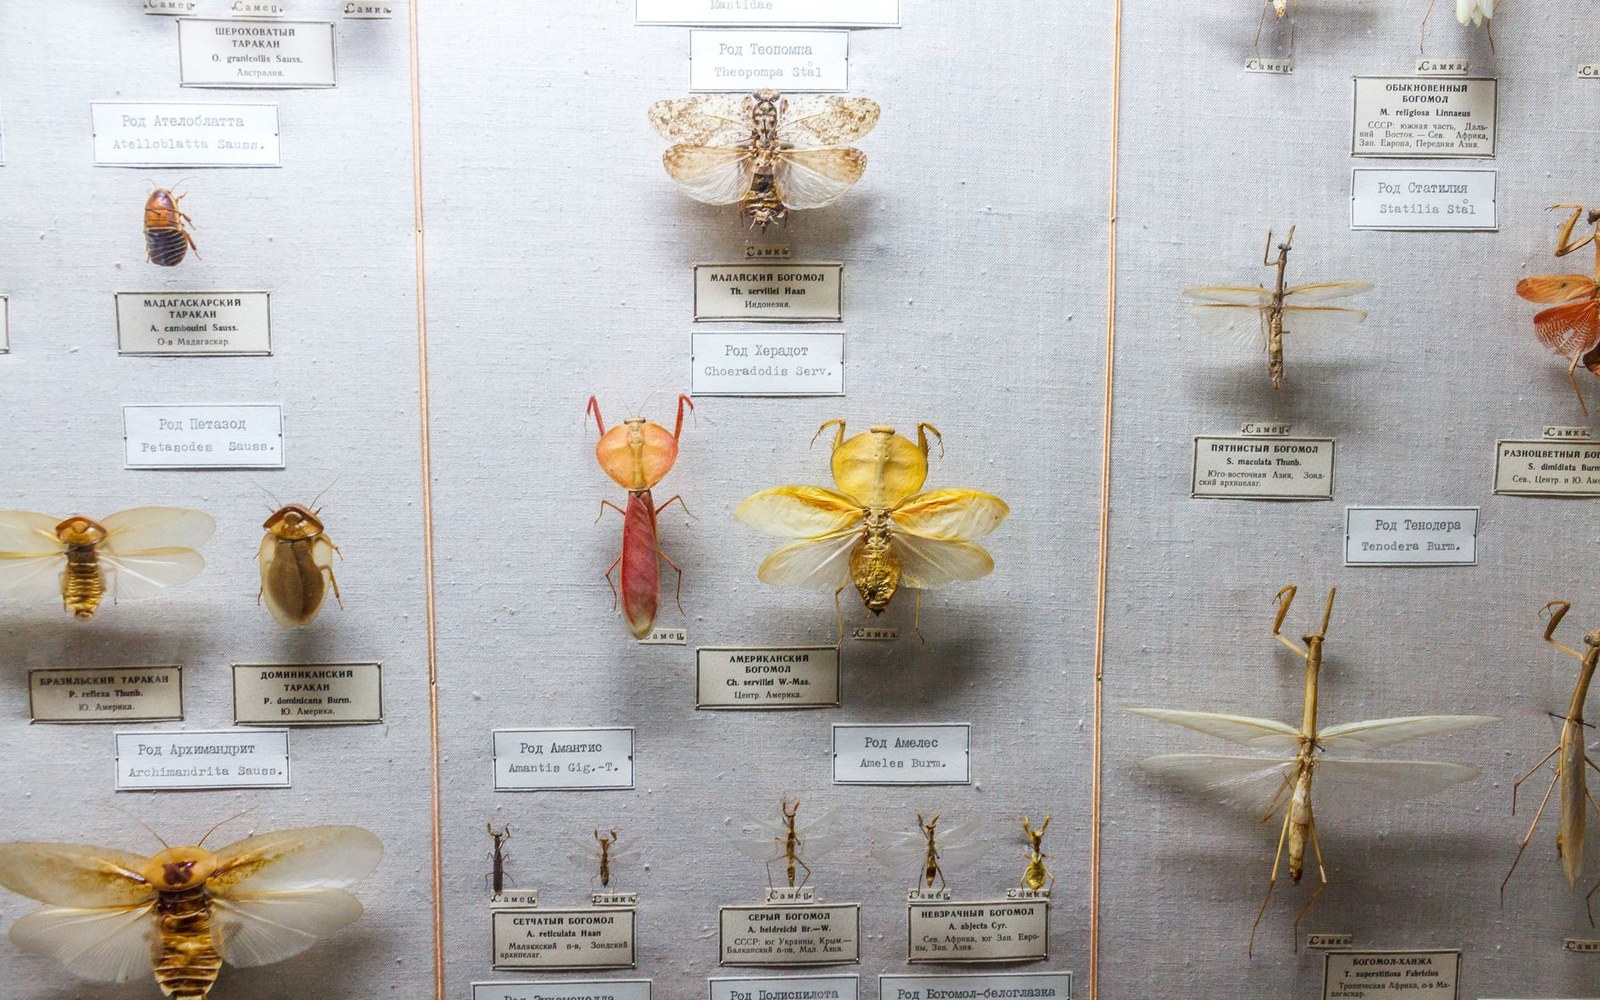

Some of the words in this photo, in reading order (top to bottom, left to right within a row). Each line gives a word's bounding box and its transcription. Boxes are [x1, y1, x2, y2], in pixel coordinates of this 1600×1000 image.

[710, 0, 773, 10] Mantidae
[215, 27, 295, 37] ШЕРОХОВАТЫЙ
[232, 40, 280, 48] ТАРАКАН
[719, 43, 742, 56] Род
[750, 43, 813, 55] Теопомпа
[276, 55, 303, 63] Sauss.
[237, 68, 284, 78] Австралия.
[714, 66, 784, 78] Theopompa
[1386, 83, 1468, 93] ОБЫКНОВЕННЫЙ
[1402, 95, 1448, 104] БОГОМОЛ
[1380, 109, 1390, 117] M.
[1396, 109, 1430, 118] religiosa
[1436, 109, 1471, 117] Linnaeus
[122, 115, 146, 127] Род
[154, 115, 244, 127] Ателоблатта
[1433, 123, 1456, 131] часть,
[1428, 131, 1444, 139] Сев.
[1456, 132, 1489, 140] Африка,
[113, 139, 209, 150] Atelloblatta
[218, 139, 265, 150] Sauss.
[1381, 140, 1412, 149] Европа,
[1416, 140, 1454, 148] Передняя
[1458, 140, 1480, 148] Азия.
[1378, 182, 1400, 194] Род
[1408, 182, 1468, 194] Статилия
[1380, 204, 1439, 214] Statilia
[710, 273, 774, 282] МАЛАЙСКИЙ
[778, 273, 824, 281] БОГОМОЛ
[730, 287, 743, 295] Th.
[144, 299, 241, 308] МАДАГАСКАРСКИЙ
[745, 301, 791, 309] Индонезия.
[169, 310, 217, 318] ТАРАКАН
[177, 338, 231, 347] Мадагаскар.
[725, 345, 748, 357] Род
[755, 345, 808, 358] Херадот
[704, 366, 788, 376] Choeradodis
[796, 367, 832, 376] Serv.
[159, 419, 183, 431] Род
[190, 418, 246, 430] Петазод
[228, 442, 274, 451] Sauss.
[1211, 445, 1270, 453] ПЯТНИСТЫЙ
[1274, 445, 1318, 453] БОГОМОЛ
[1504, 449, 1580, 459] РАЗНОЦВЕТНЫЙ
[1272, 471, 1293, 479] Азия,
[1572, 476, 1582, 484] Ю.
[1375, 519, 1397, 531] Род
[1404, 520, 1461, 532] Тенодера
[1362, 542, 1419, 551] Tenodera
[1427, 542, 1460, 551] Burm.
[646, 630, 684, 641] амец
[730, 654, 809, 664] АМЕРИКАНСКИЙ
[745, 665, 791, 674] БОГОМОЛ
[261, 670, 353, 680] ДОМИНИКАНСКИЙ
[40, 676, 114, 686] БРАЗИЛЬСКИЙ
[123, 675, 169, 684] ТАРАКАН
[726, 678, 740, 687] Ch.
[766, 690, 802, 699] Америка.
[328, 696, 352, 704] Burm.
[78, 703, 91, 711] Ю.
[95, 703, 135, 712] Америка.
[281, 708, 293, 716] Ю.
[297, 708, 335, 716] Америка.
[864, 737, 887, 748] Род
[895, 737, 938, 748] Амелес
[138, 744, 162, 756] Род
[170, 743, 255, 757] Архимандрит
[520, 743, 543, 755] Род
[551, 742, 602, 754] Амантис
[860, 758, 904, 768] Ameles
[912, 759, 946, 768] Burm.
[128, 766, 229, 777] Archimandrita
[238, 766, 282, 776] Sauss.
[509, 763, 560, 773] Amantis
[568, 762, 618, 774] Gig.-T.
[749, 913, 780, 921] СЕРЫЙ
[921, 910, 984, 918] НЕВЗРАЧНЫЙ
[990, 909, 1034, 917] БОГОМОЛ
[513, 917, 564, 926] СЕТЧАТЫЙ
[569, 917, 614, 925] БОГОМОЛ
[961, 922, 988, 930] abjecta
[992, 922, 1007, 930] Cyr.
[581, 929, 601, 937] Haan
[591, 941, 628, 949] Зондский
[1567, 940, 1600, 950] Самк
[730, 991, 752, 1000] Род
[759, 989, 839, 1000] Полиспилота
[897, 989, 920, 1000] Род
[926, 987, 1055, 1000] Богомол-белоглазка
